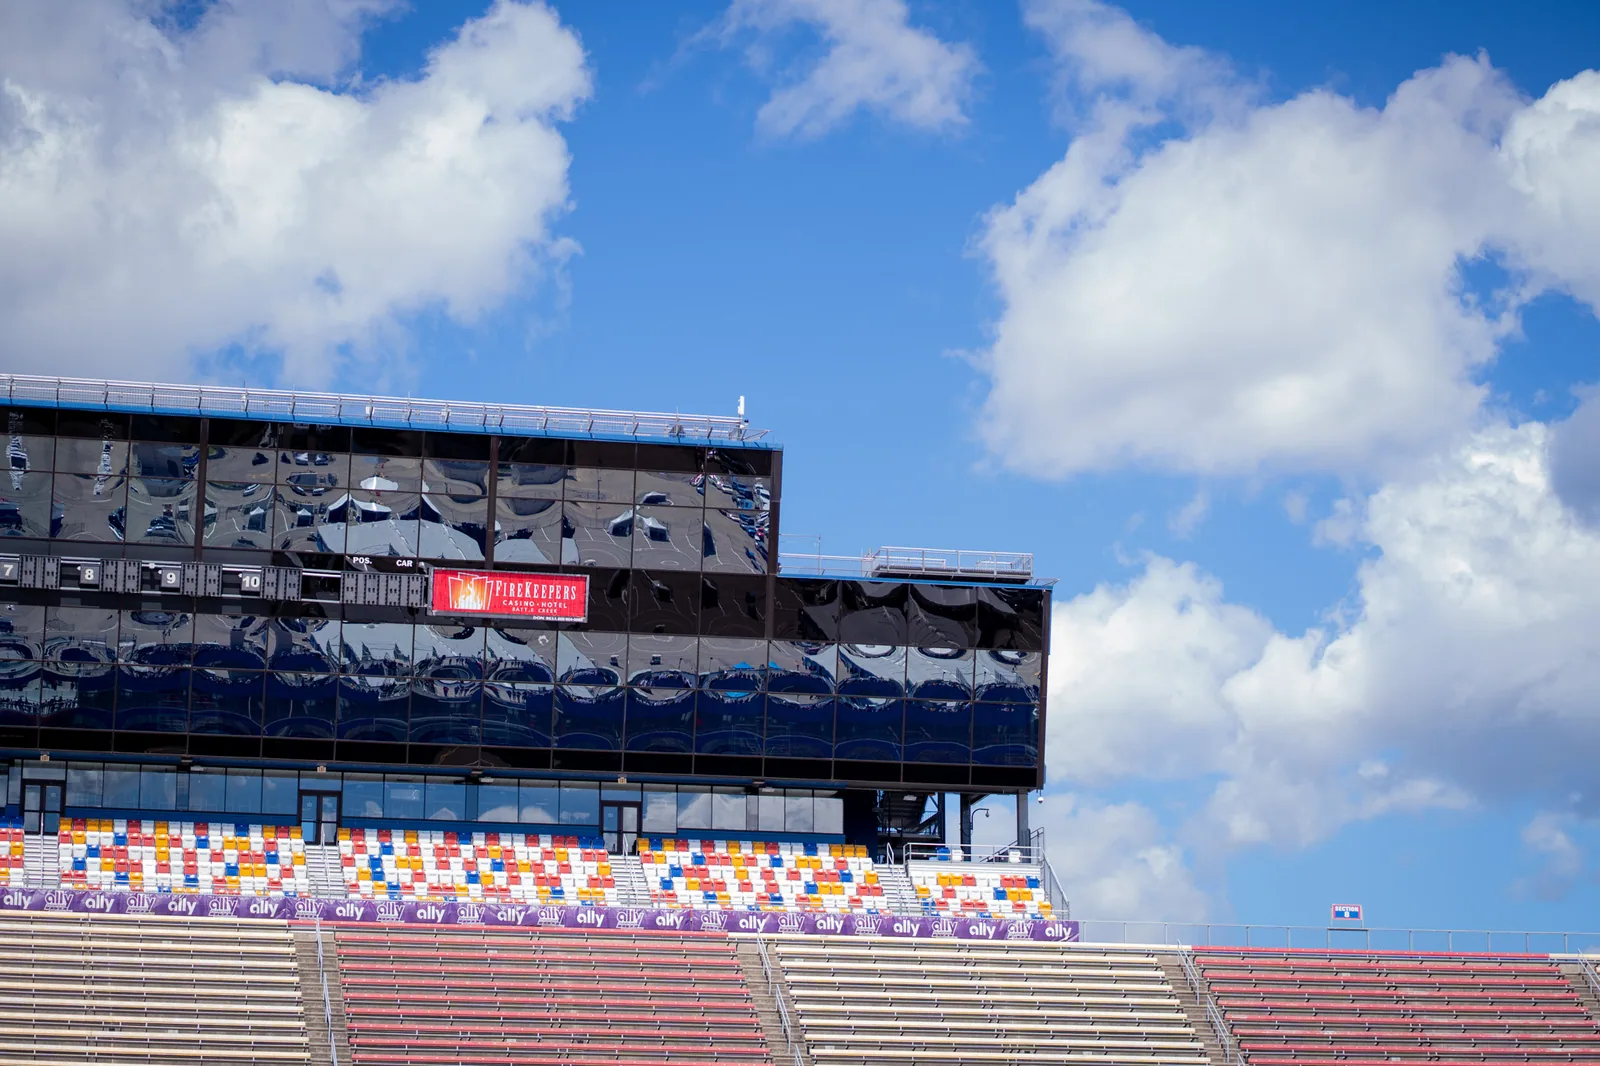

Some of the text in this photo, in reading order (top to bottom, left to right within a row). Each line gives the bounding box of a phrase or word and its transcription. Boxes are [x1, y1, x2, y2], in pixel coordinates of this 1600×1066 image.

[3, 564, 13, 576] 7
[85, 569, 94, 580] 8
[166, 572, 176, 584] 9
[242, 576, 260, 588] 10
[4, 892, 32, 909] ally
[44, 891, 74, 908] ally
[86, 895, 114, 912] ally
[126, 893, 156, 912] ally
[168, 897, 196, 915] ally
[209, 897, 238, 914] ally
[250, 900, 278, 917] ally
[295, 899, 324, 917] ally
[336, 904, 364, 920] ally
[377, 902, 405, 919] ally
[417, 906, 445, 923] ally
[458, 904, 485, 921] ally
[498, 908, 525, 924] ally
[538, 906, 565, 924] ally
[577, 910, 604, 927] ally
[617, 908, 644, 926] ally
[656, 914, 683, 929] ally
[701, 911, 727, 928] ally
[740, 916, 767, 932] ally
[778, 913, 805, 930] ally
[817, 917, 844, 933] ally
[856, 916, 882, 932] ally
[893, 920, 920, 936] ally
[932, 918, 958, 935] ally
[969, 923, 995, 938] ally
[1008, 920, 1034, 937] ally
[1045, 924, 1072, 940] ally
